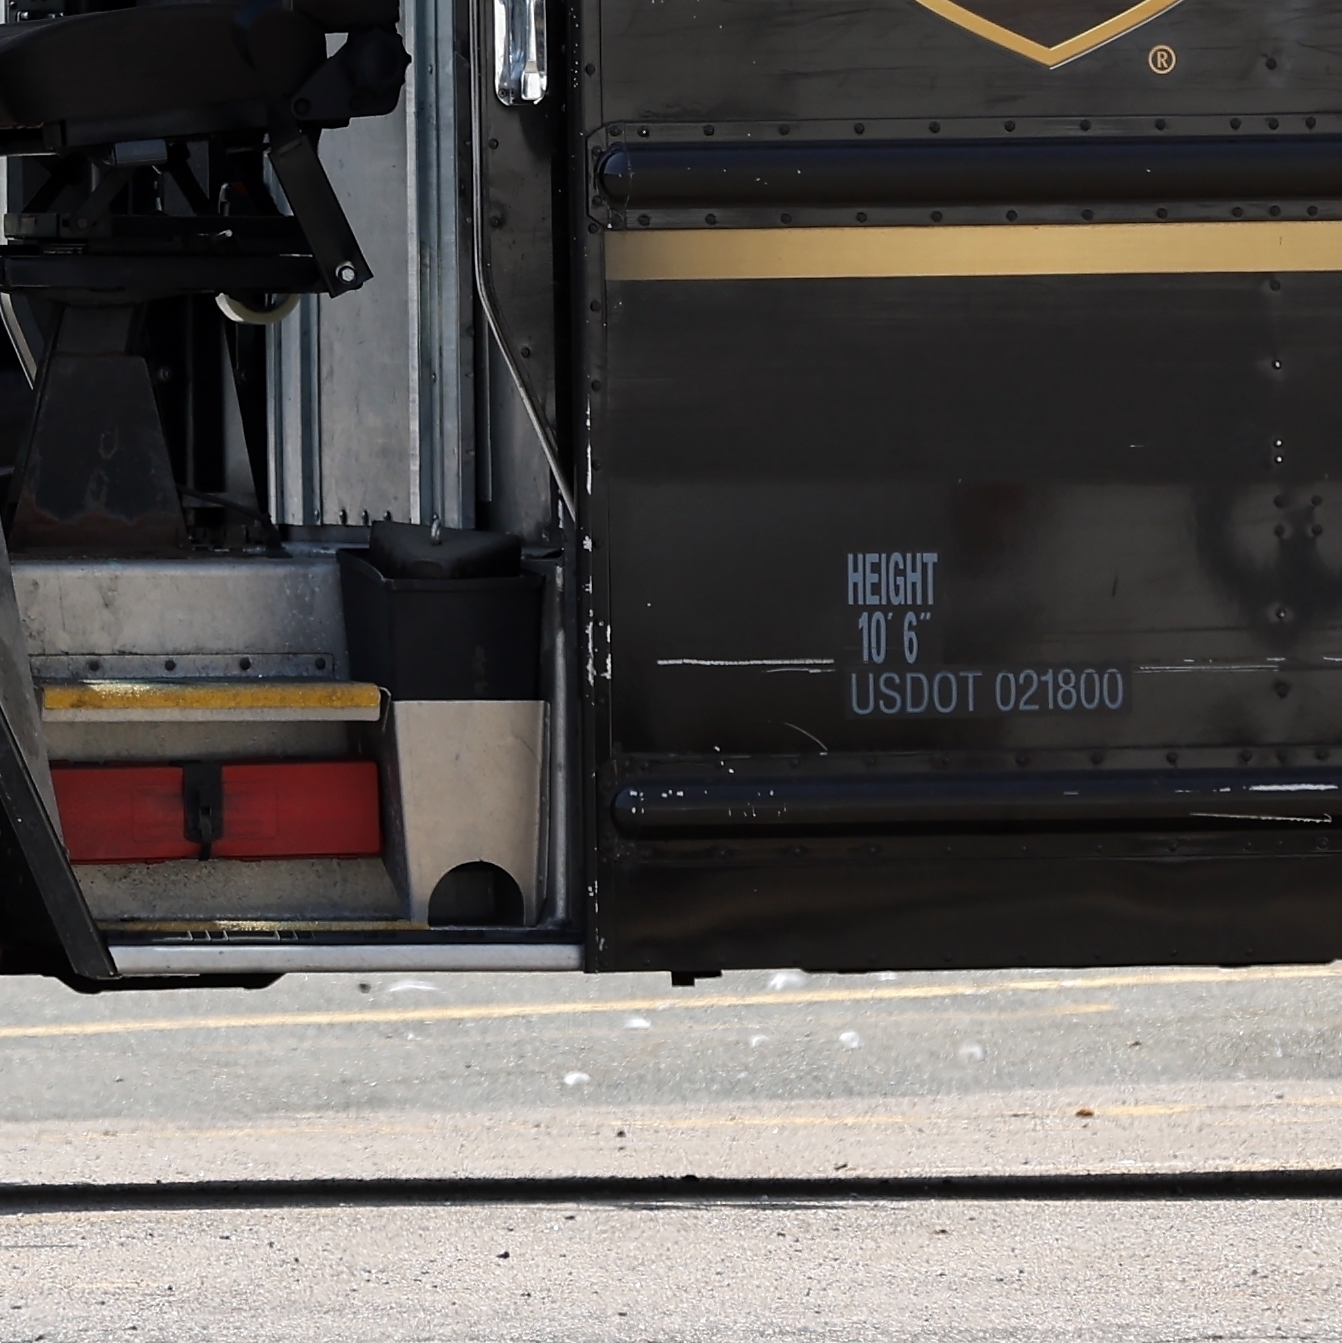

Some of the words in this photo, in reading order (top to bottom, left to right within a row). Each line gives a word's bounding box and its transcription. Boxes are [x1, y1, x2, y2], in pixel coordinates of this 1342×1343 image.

[847, 552, 938, 606] HEIGHT
[851, 670, 983, 716] USDOT
[995, 668, 1125, 712] 021800
